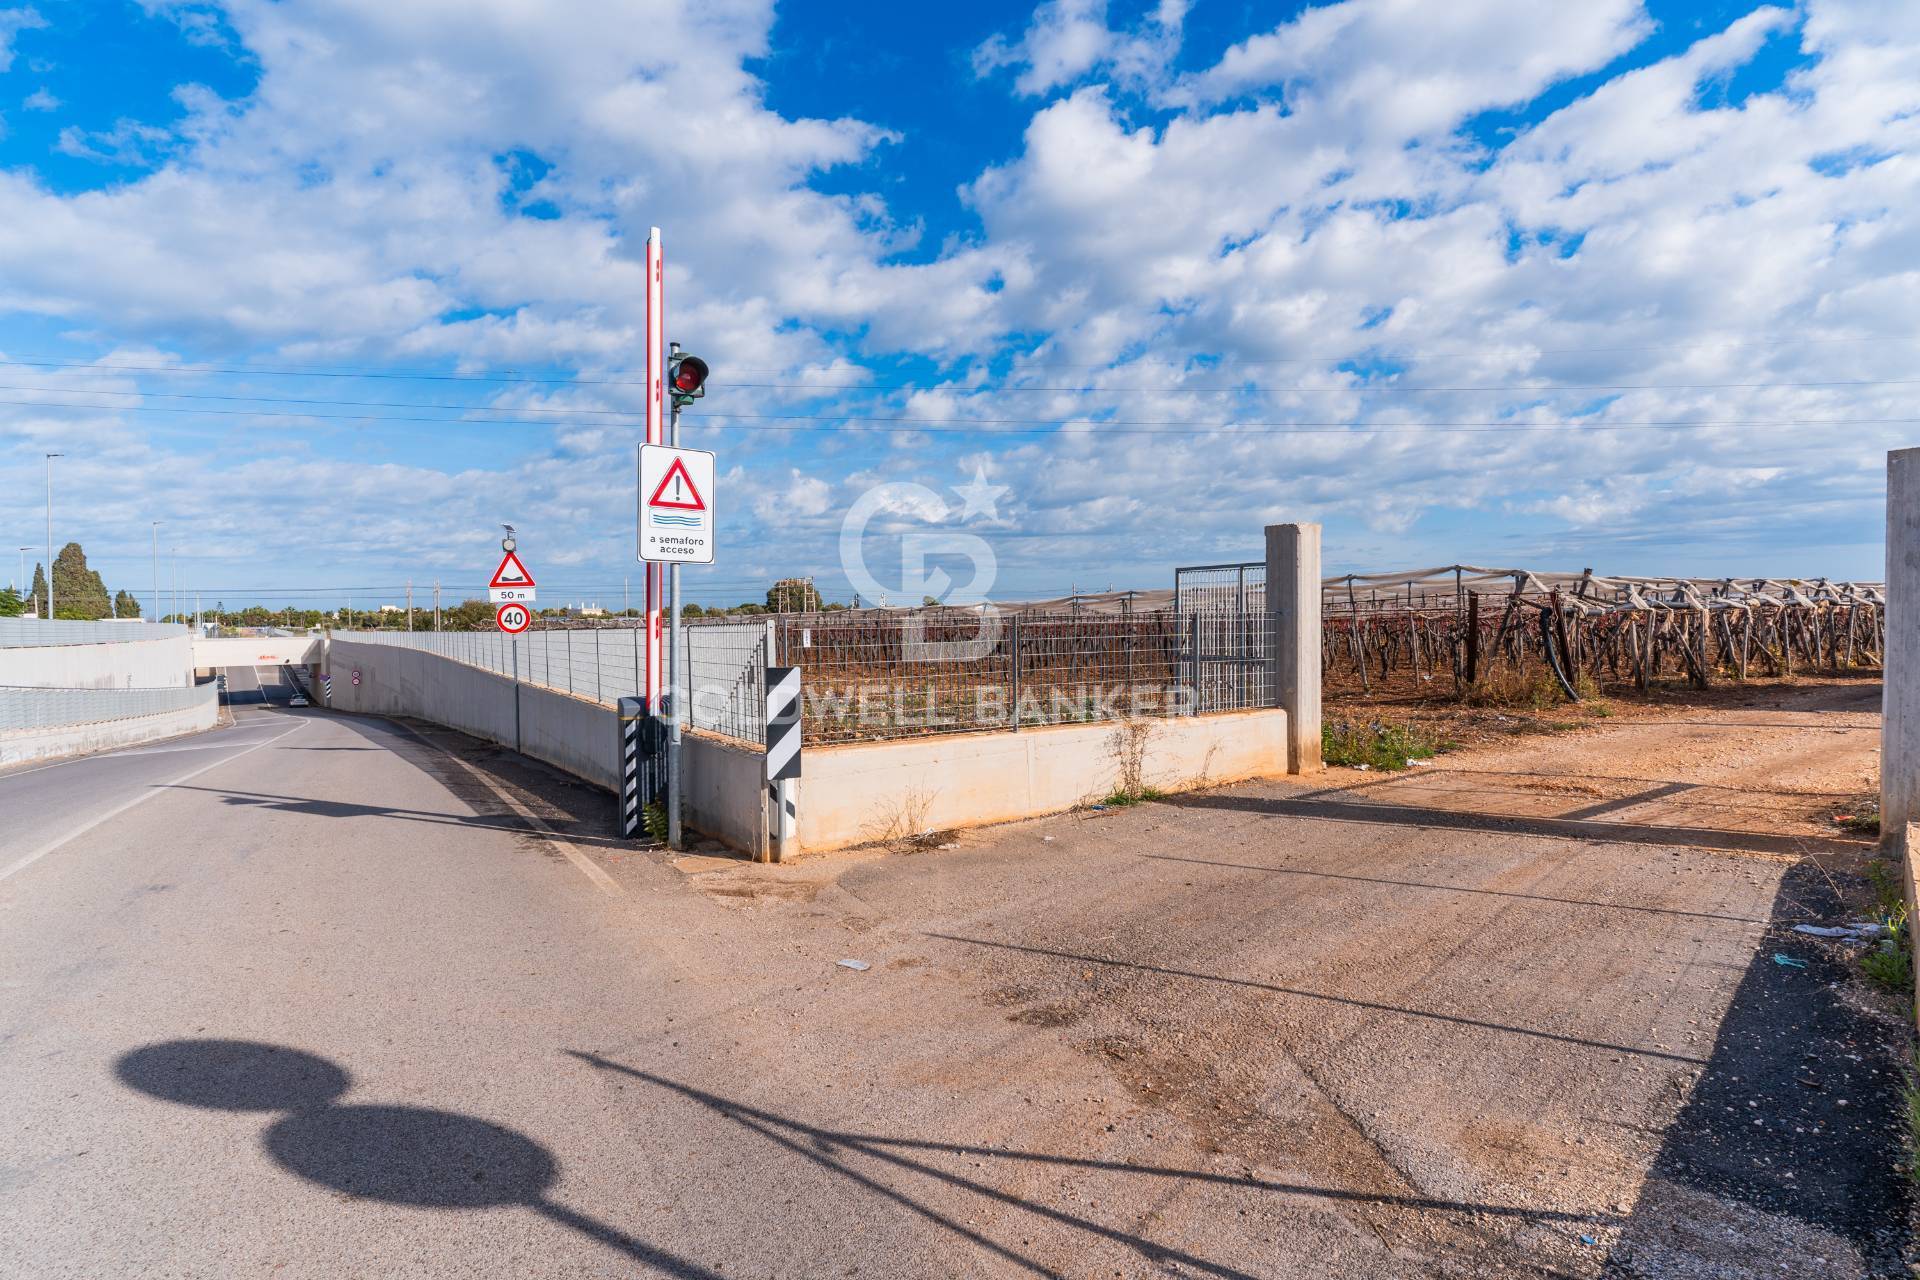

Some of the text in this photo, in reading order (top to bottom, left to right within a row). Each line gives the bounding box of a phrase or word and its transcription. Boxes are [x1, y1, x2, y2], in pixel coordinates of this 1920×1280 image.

[659, 536, 704, 546] semaforo
[660, 546, 695, 555] acceso
[501, 591, 514, 599] 50
[504, 612, 523, 625] 40
